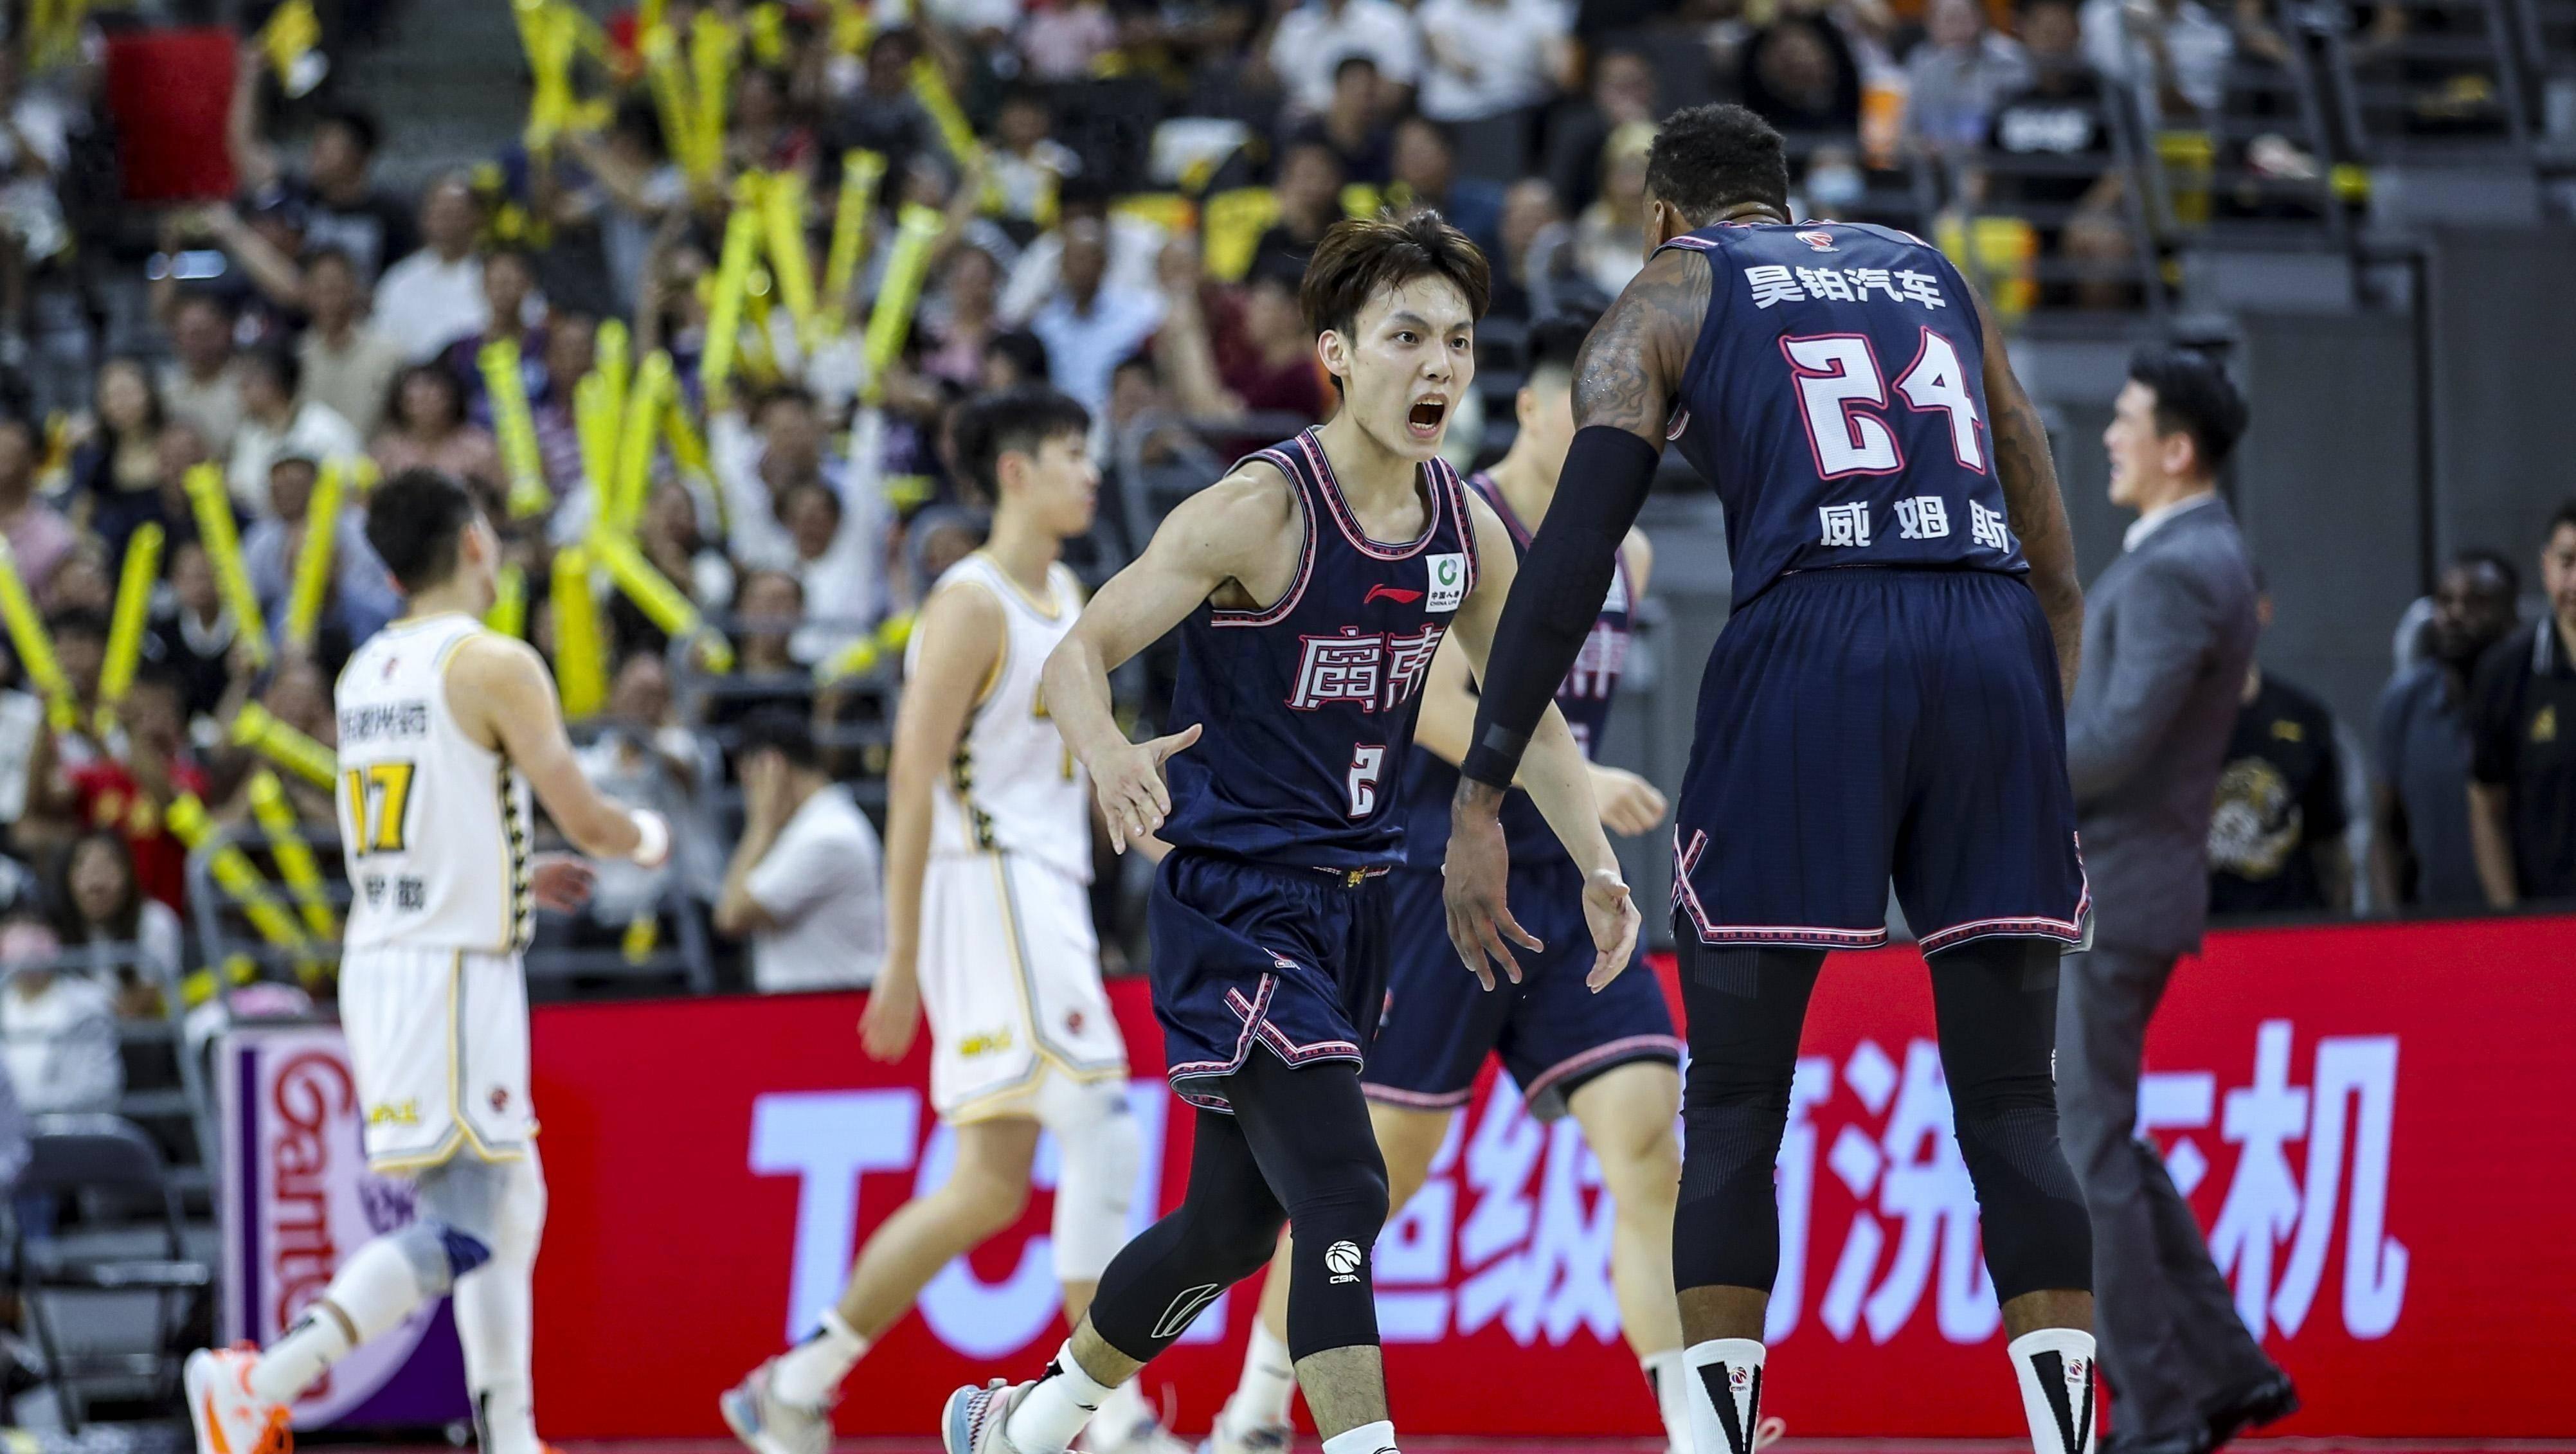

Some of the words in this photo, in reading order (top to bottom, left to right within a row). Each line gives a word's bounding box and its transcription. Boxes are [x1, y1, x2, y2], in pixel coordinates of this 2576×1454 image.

[1743, 265, 1946, 310] 昊铂汽车
[1779, 326, 1986, 480] 24
[1819, 496, 2010, 554] 威姆斯
[346, 761, 415, 858] 17
[1347, 742, 1387, 818] 2
[1329, 1274, 1361, 1284] CBA
